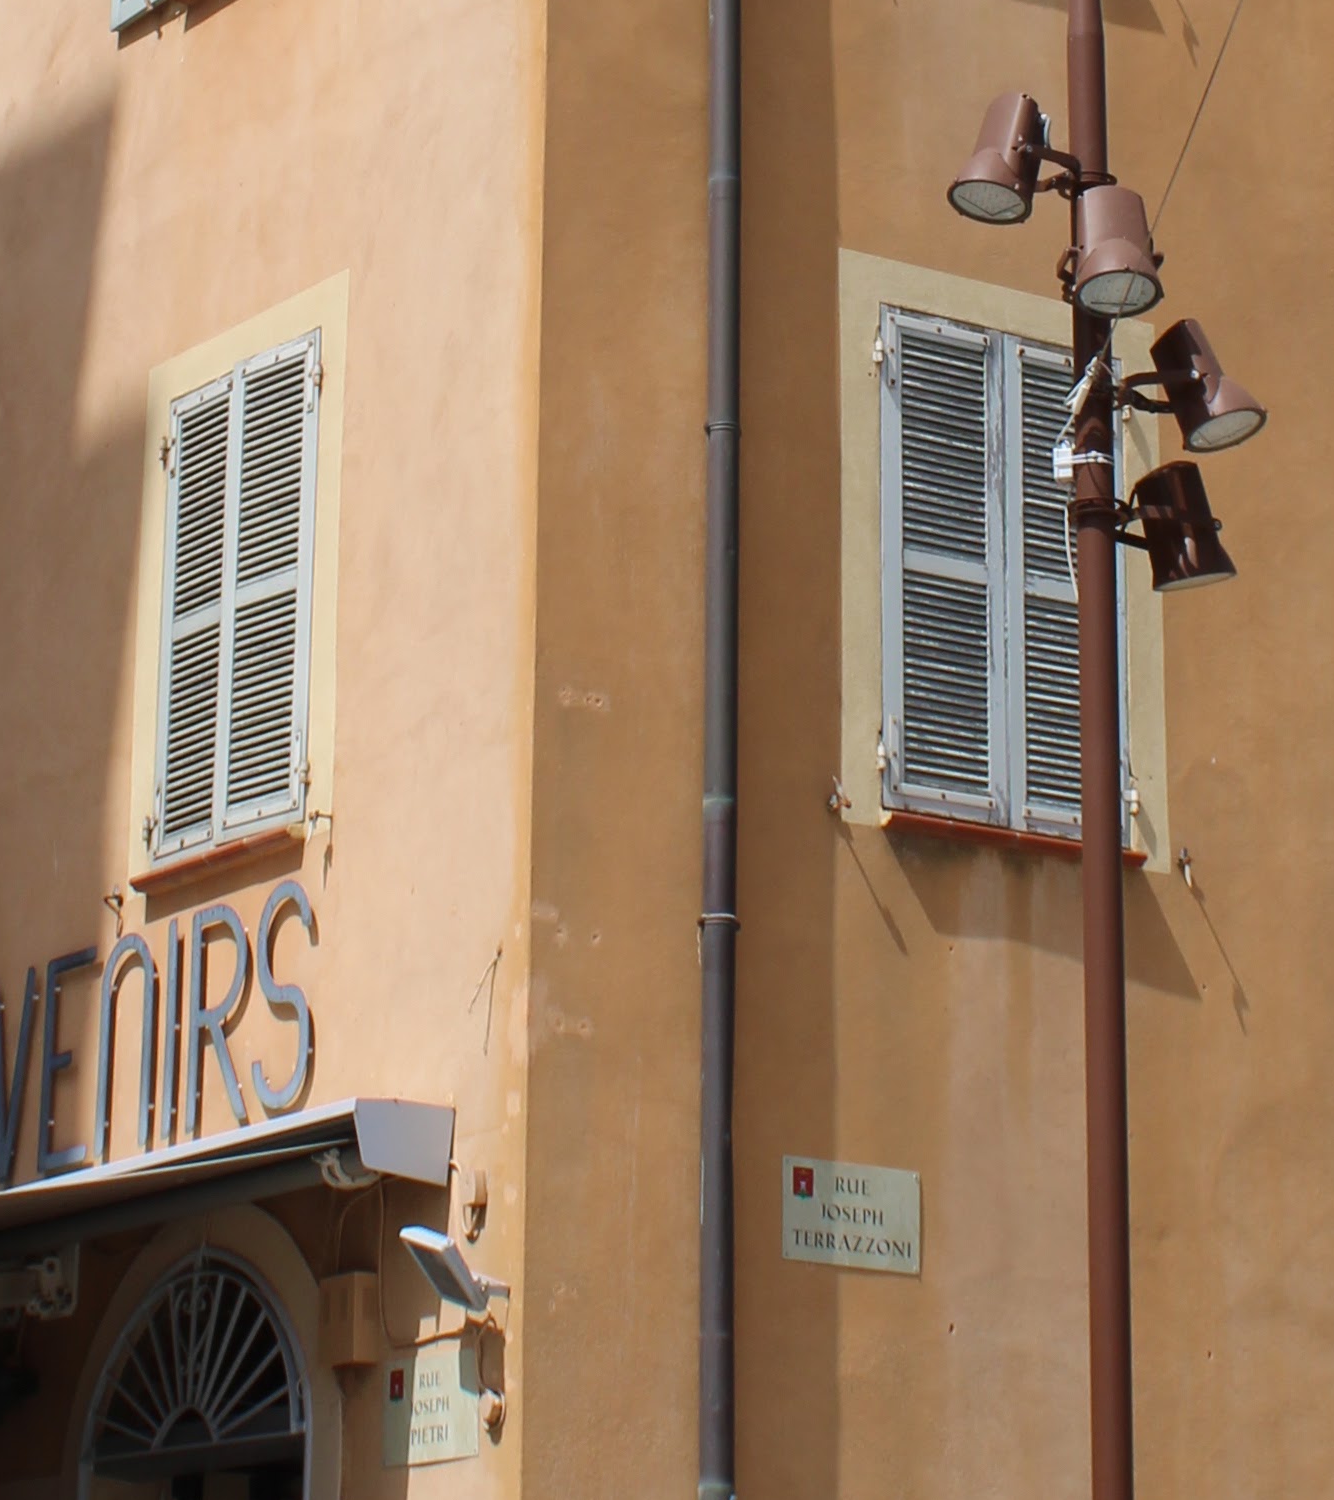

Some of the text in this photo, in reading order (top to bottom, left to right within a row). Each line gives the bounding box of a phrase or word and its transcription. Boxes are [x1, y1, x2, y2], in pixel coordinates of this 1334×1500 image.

[835, 1176, 872, 1197] RUE
[793, 1229, 912, 1258] TERRAZZONI
[419, 1371, 441, 1390] RUE
[411, 1424, 449, 1446] PIETRI
